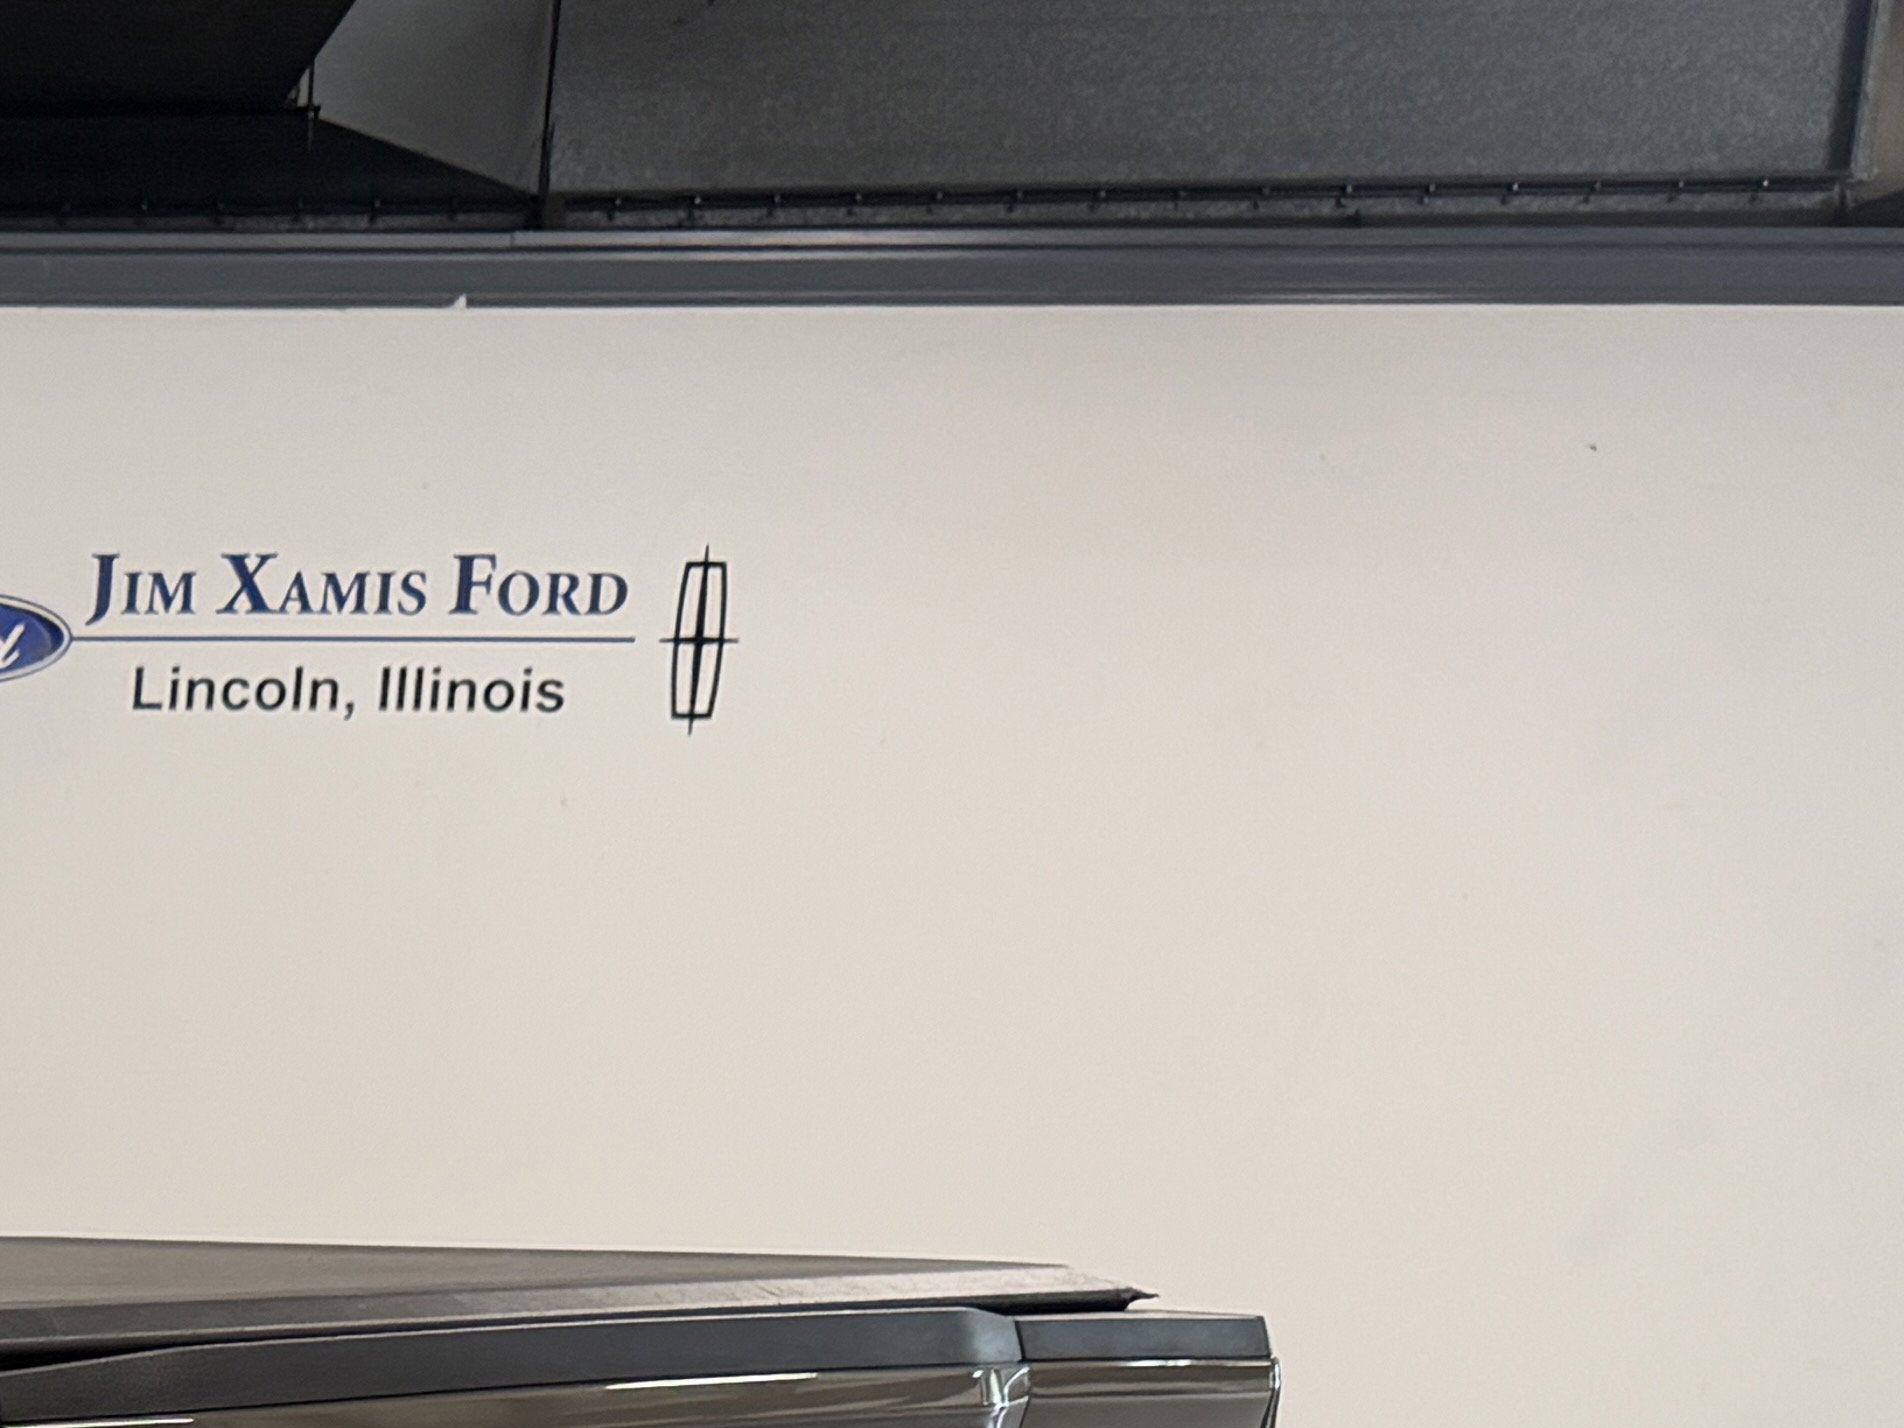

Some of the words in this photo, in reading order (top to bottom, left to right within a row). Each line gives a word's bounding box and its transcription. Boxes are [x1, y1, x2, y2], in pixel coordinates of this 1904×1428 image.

[85, 552, 198, 627] JIM
[216, 552, 429, 617] XAMIS
[448, 553, 631, 619] FORD
[130, 664, 357, 720] Lincoln,
[378, 664, 567, 714] Illinois
